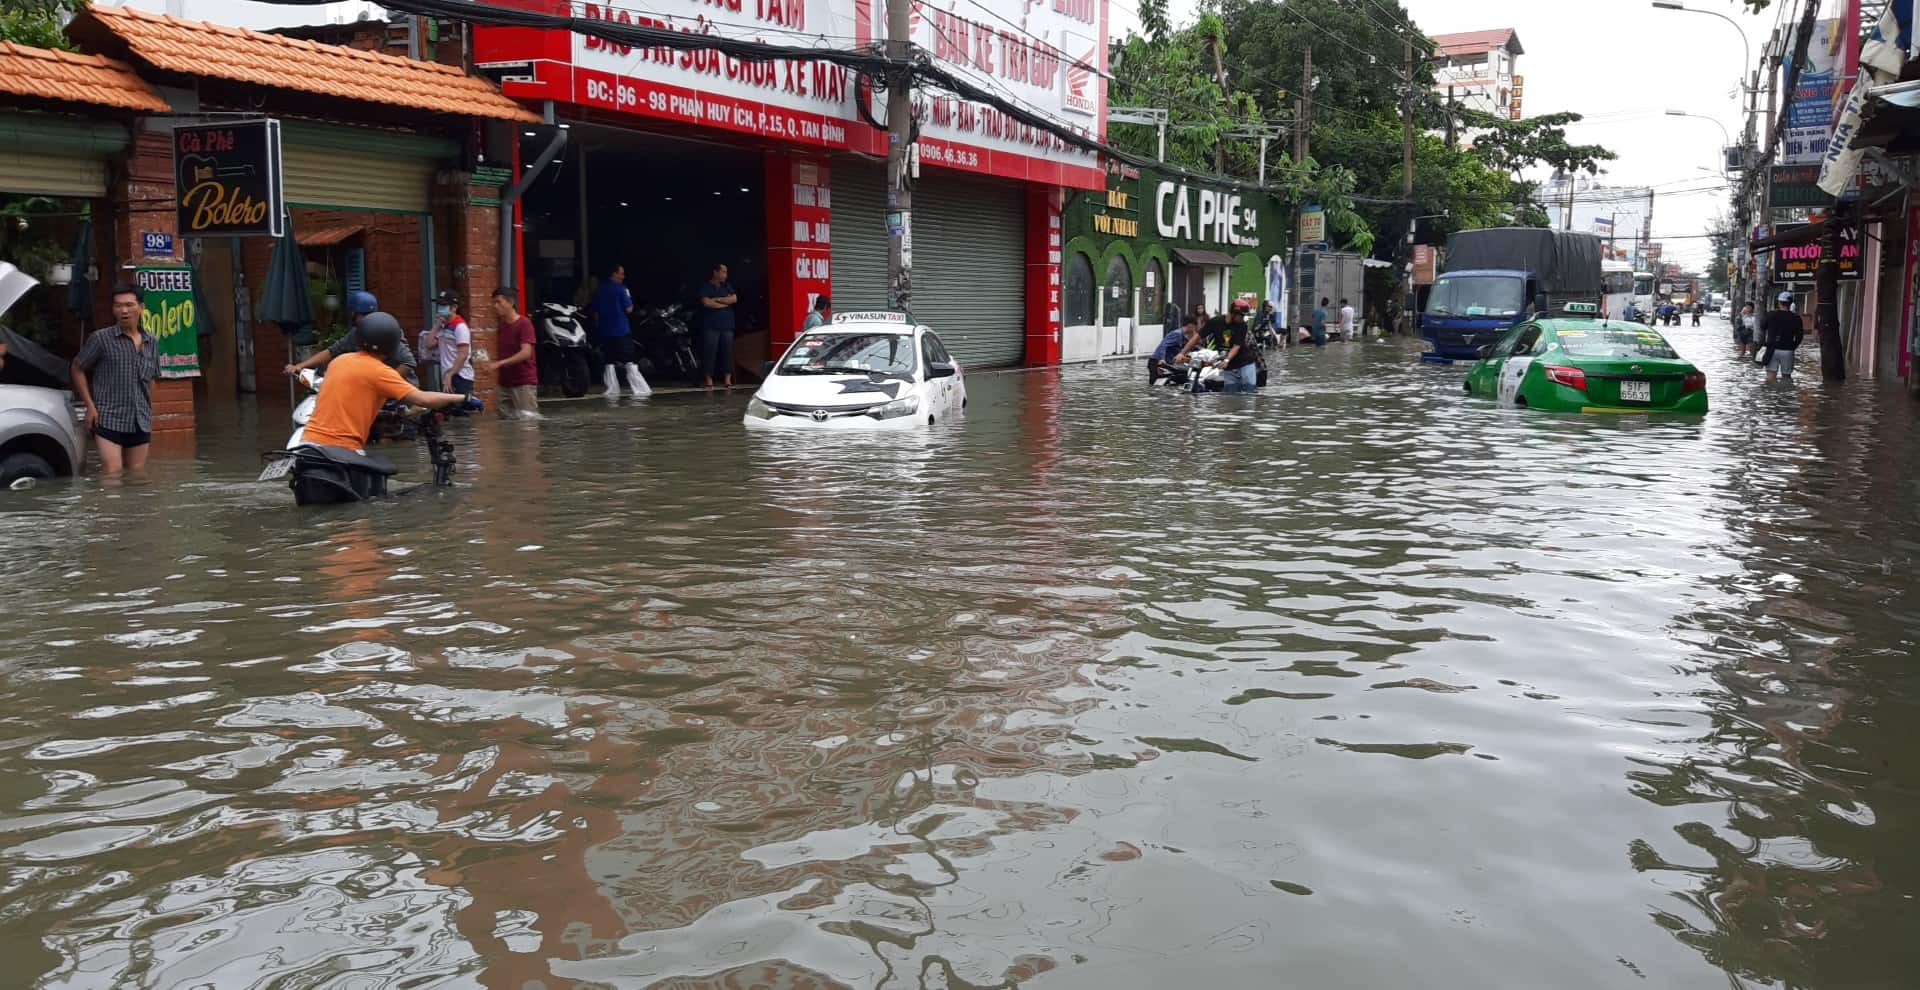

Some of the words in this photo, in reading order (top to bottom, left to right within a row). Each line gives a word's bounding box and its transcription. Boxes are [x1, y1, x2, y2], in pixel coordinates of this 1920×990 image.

[973, 19, 994, 74] XE
[587, 79, 614, 102] ĐC:
[617, 84, 636, 106] 96
[648, 90, 667, 111] 98
[670, 94, 703, 118] PHAN
[707, 102, 730, 122] HUY
[1066, 95, 1095, 111] HONDA
[180, 131, 200, 153] Cà
[205, 129, 234, 152] Phê
[921, 144, 978, 167] 0906.46.36.36
[182, 181, 266, 230] Bolero
[1112, 217, 1138, 237] NHAU
[1243, 208, 1257, 231] 94
[136, 270, 192, 292] COFFEE
[141, 300, 195, 341] Bolero
[849, 312, 887, 321] VINASUN
